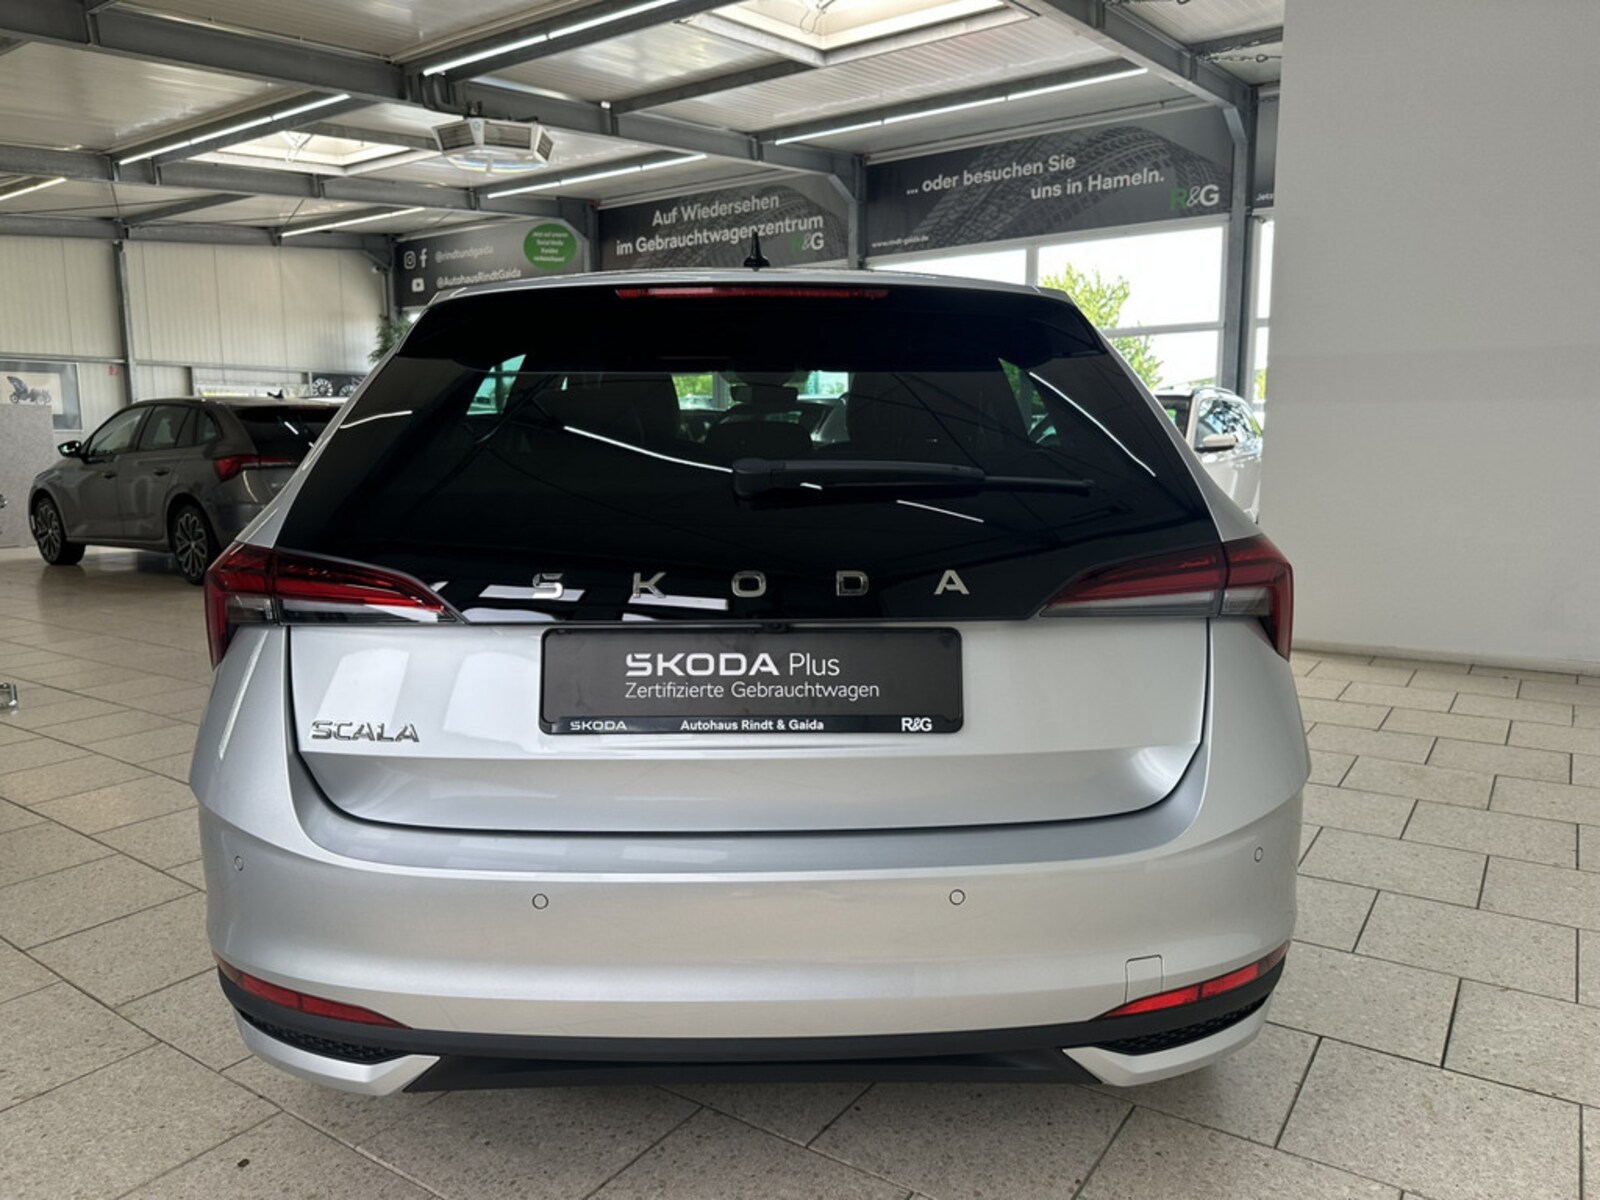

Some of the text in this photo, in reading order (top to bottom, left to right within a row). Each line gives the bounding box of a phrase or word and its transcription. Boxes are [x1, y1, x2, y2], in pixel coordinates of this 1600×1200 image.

[922, 174, 960, 193] oder
[963, 161, 1043, 186] besuchen
[1048, 155, 1076, 172] Sie
[1030, 168, 1165, 200] uns in Hameln.
[652, 194, 779, 227] Auf Wiedersehen
[1169, 184, 1220, 211] R&G
[616, 215, 824, 256] im Gebrauchtwagenzentrum
[789, 652, 841, 677] Plus
[625, 681, 880, 702] Zertifizierte Gebrauchtwagen
[311, 720, 420, 742] SCALA
[680, 719, 739, 732] Autohaus
[741, 719, 773, 732] Rindt
[776, 720, 787, 732] &
[789, 719, 825, 732] Gaida
[901, 717, 933, 732] R&G
